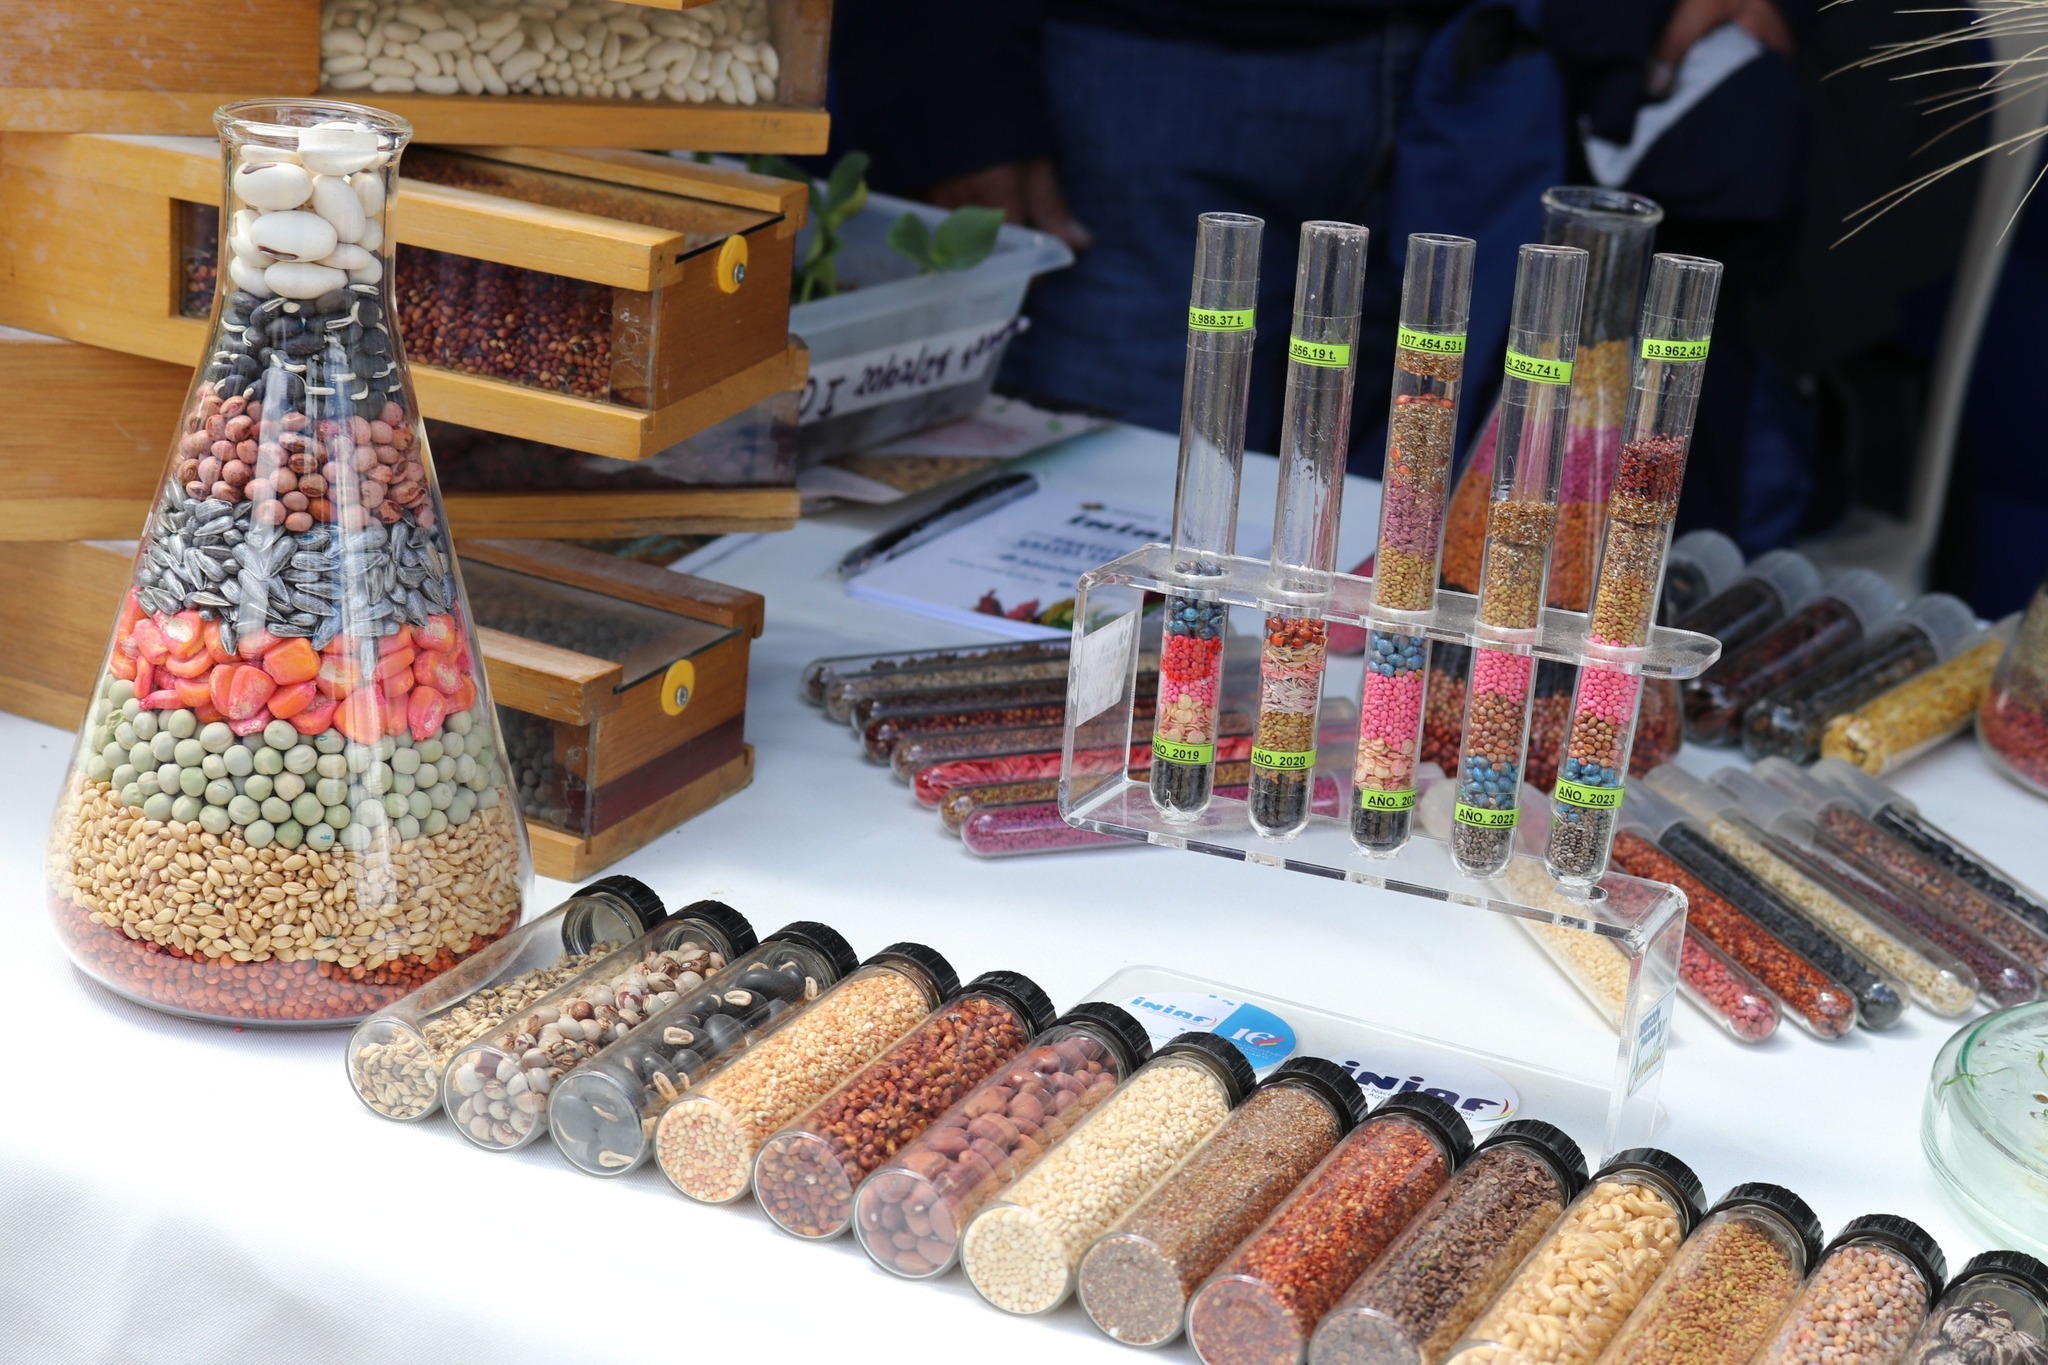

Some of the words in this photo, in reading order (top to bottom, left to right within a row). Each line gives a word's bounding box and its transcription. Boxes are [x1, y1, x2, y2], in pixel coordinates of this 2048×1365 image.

[1648, 344, 1702, 358] 93.962,42
[1172, 749, 1200, 760] 2019
[1253, 750, 1276, 765] AÑO.
[1279, 756, 1306, 766] 2020
[1368, 794, 1399, 807] AÑO.
[1559, 786, 1585, 802] AÑO.
[1589, 794, 1615, 804] 2023
[1459, 808, 1486, 823] AÑO.
[1490, 814, 1515, 824] 2022
